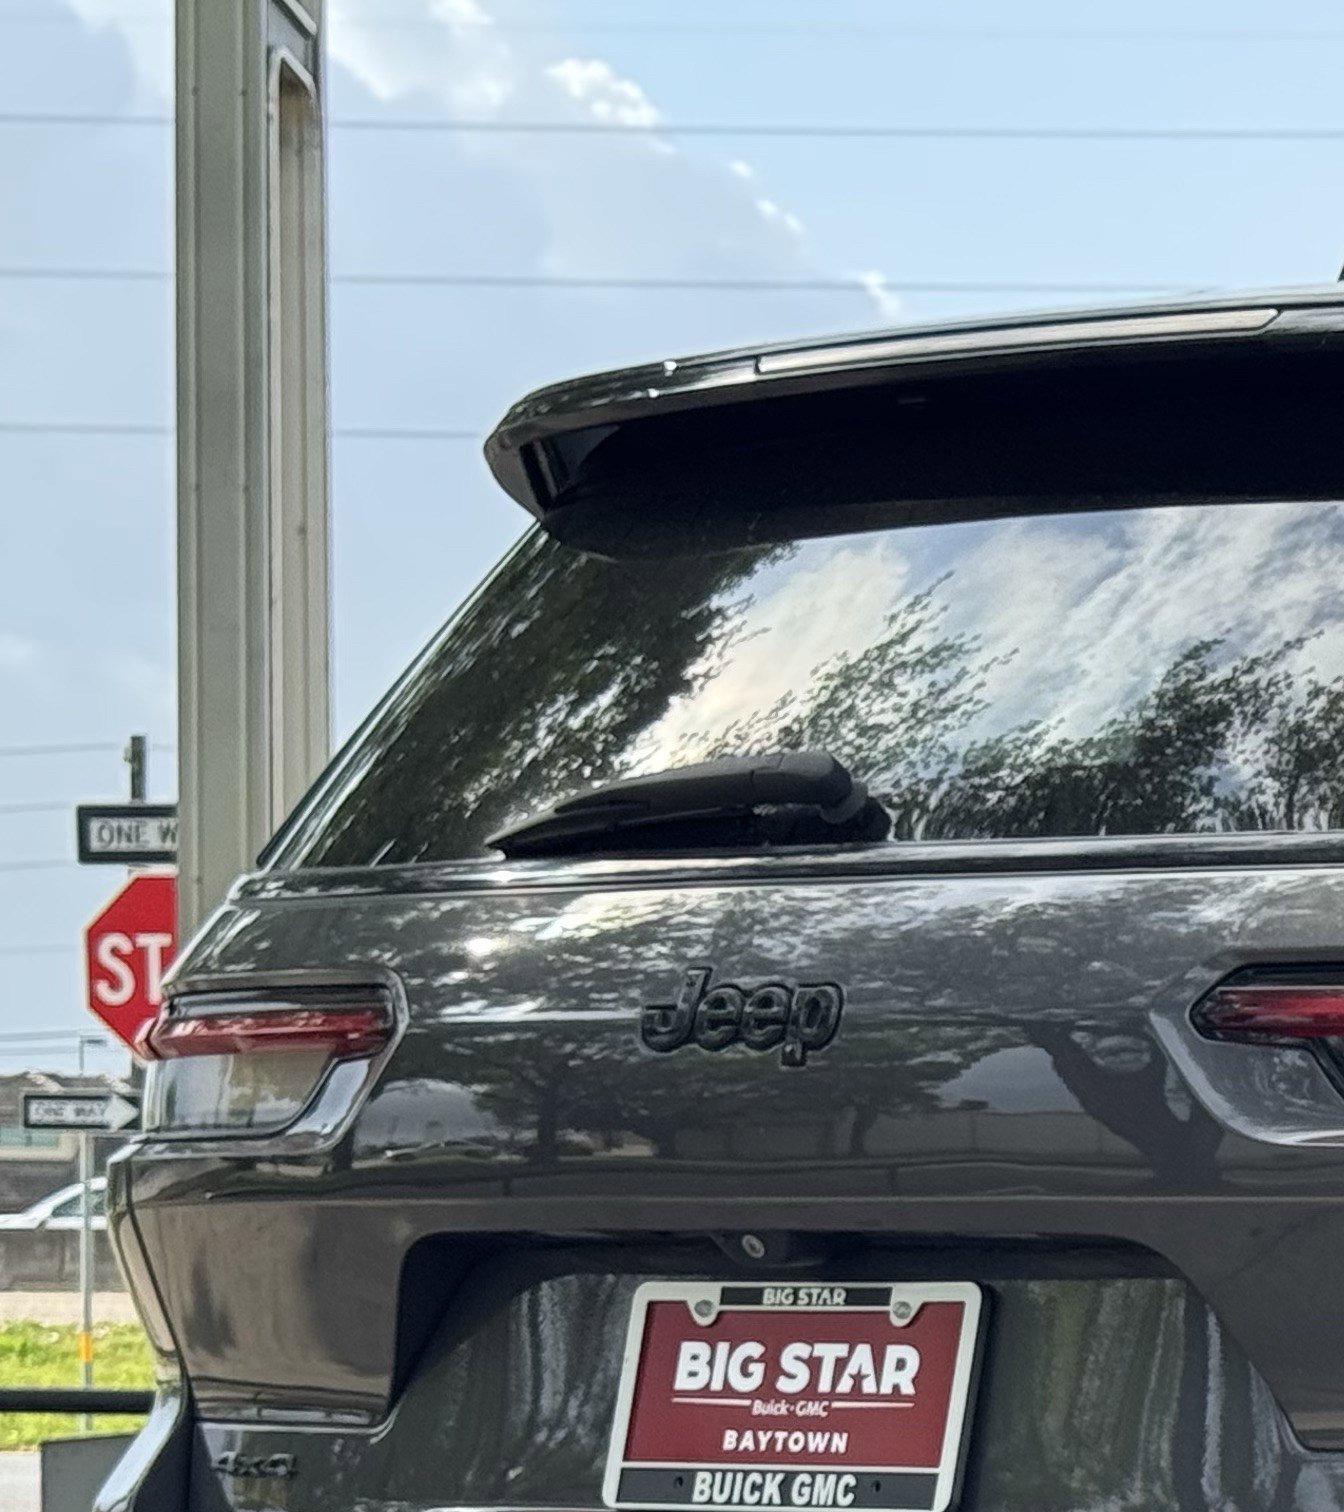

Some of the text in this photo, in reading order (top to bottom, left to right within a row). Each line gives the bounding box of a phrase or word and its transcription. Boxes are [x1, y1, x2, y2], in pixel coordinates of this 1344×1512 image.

[97, 820, 149, 848] ONE
[95, 932, 172, 1005] ST
[641, 982, 843, 1067] Jeep
[762, 1287, 846, 1306] BIG STAR
[673, 1341, 920, 1396] BIG STAR
[722, 1429, 850, 1454] BAYTOWN
[692, 1471, 857, 1507] BUICK GMC
